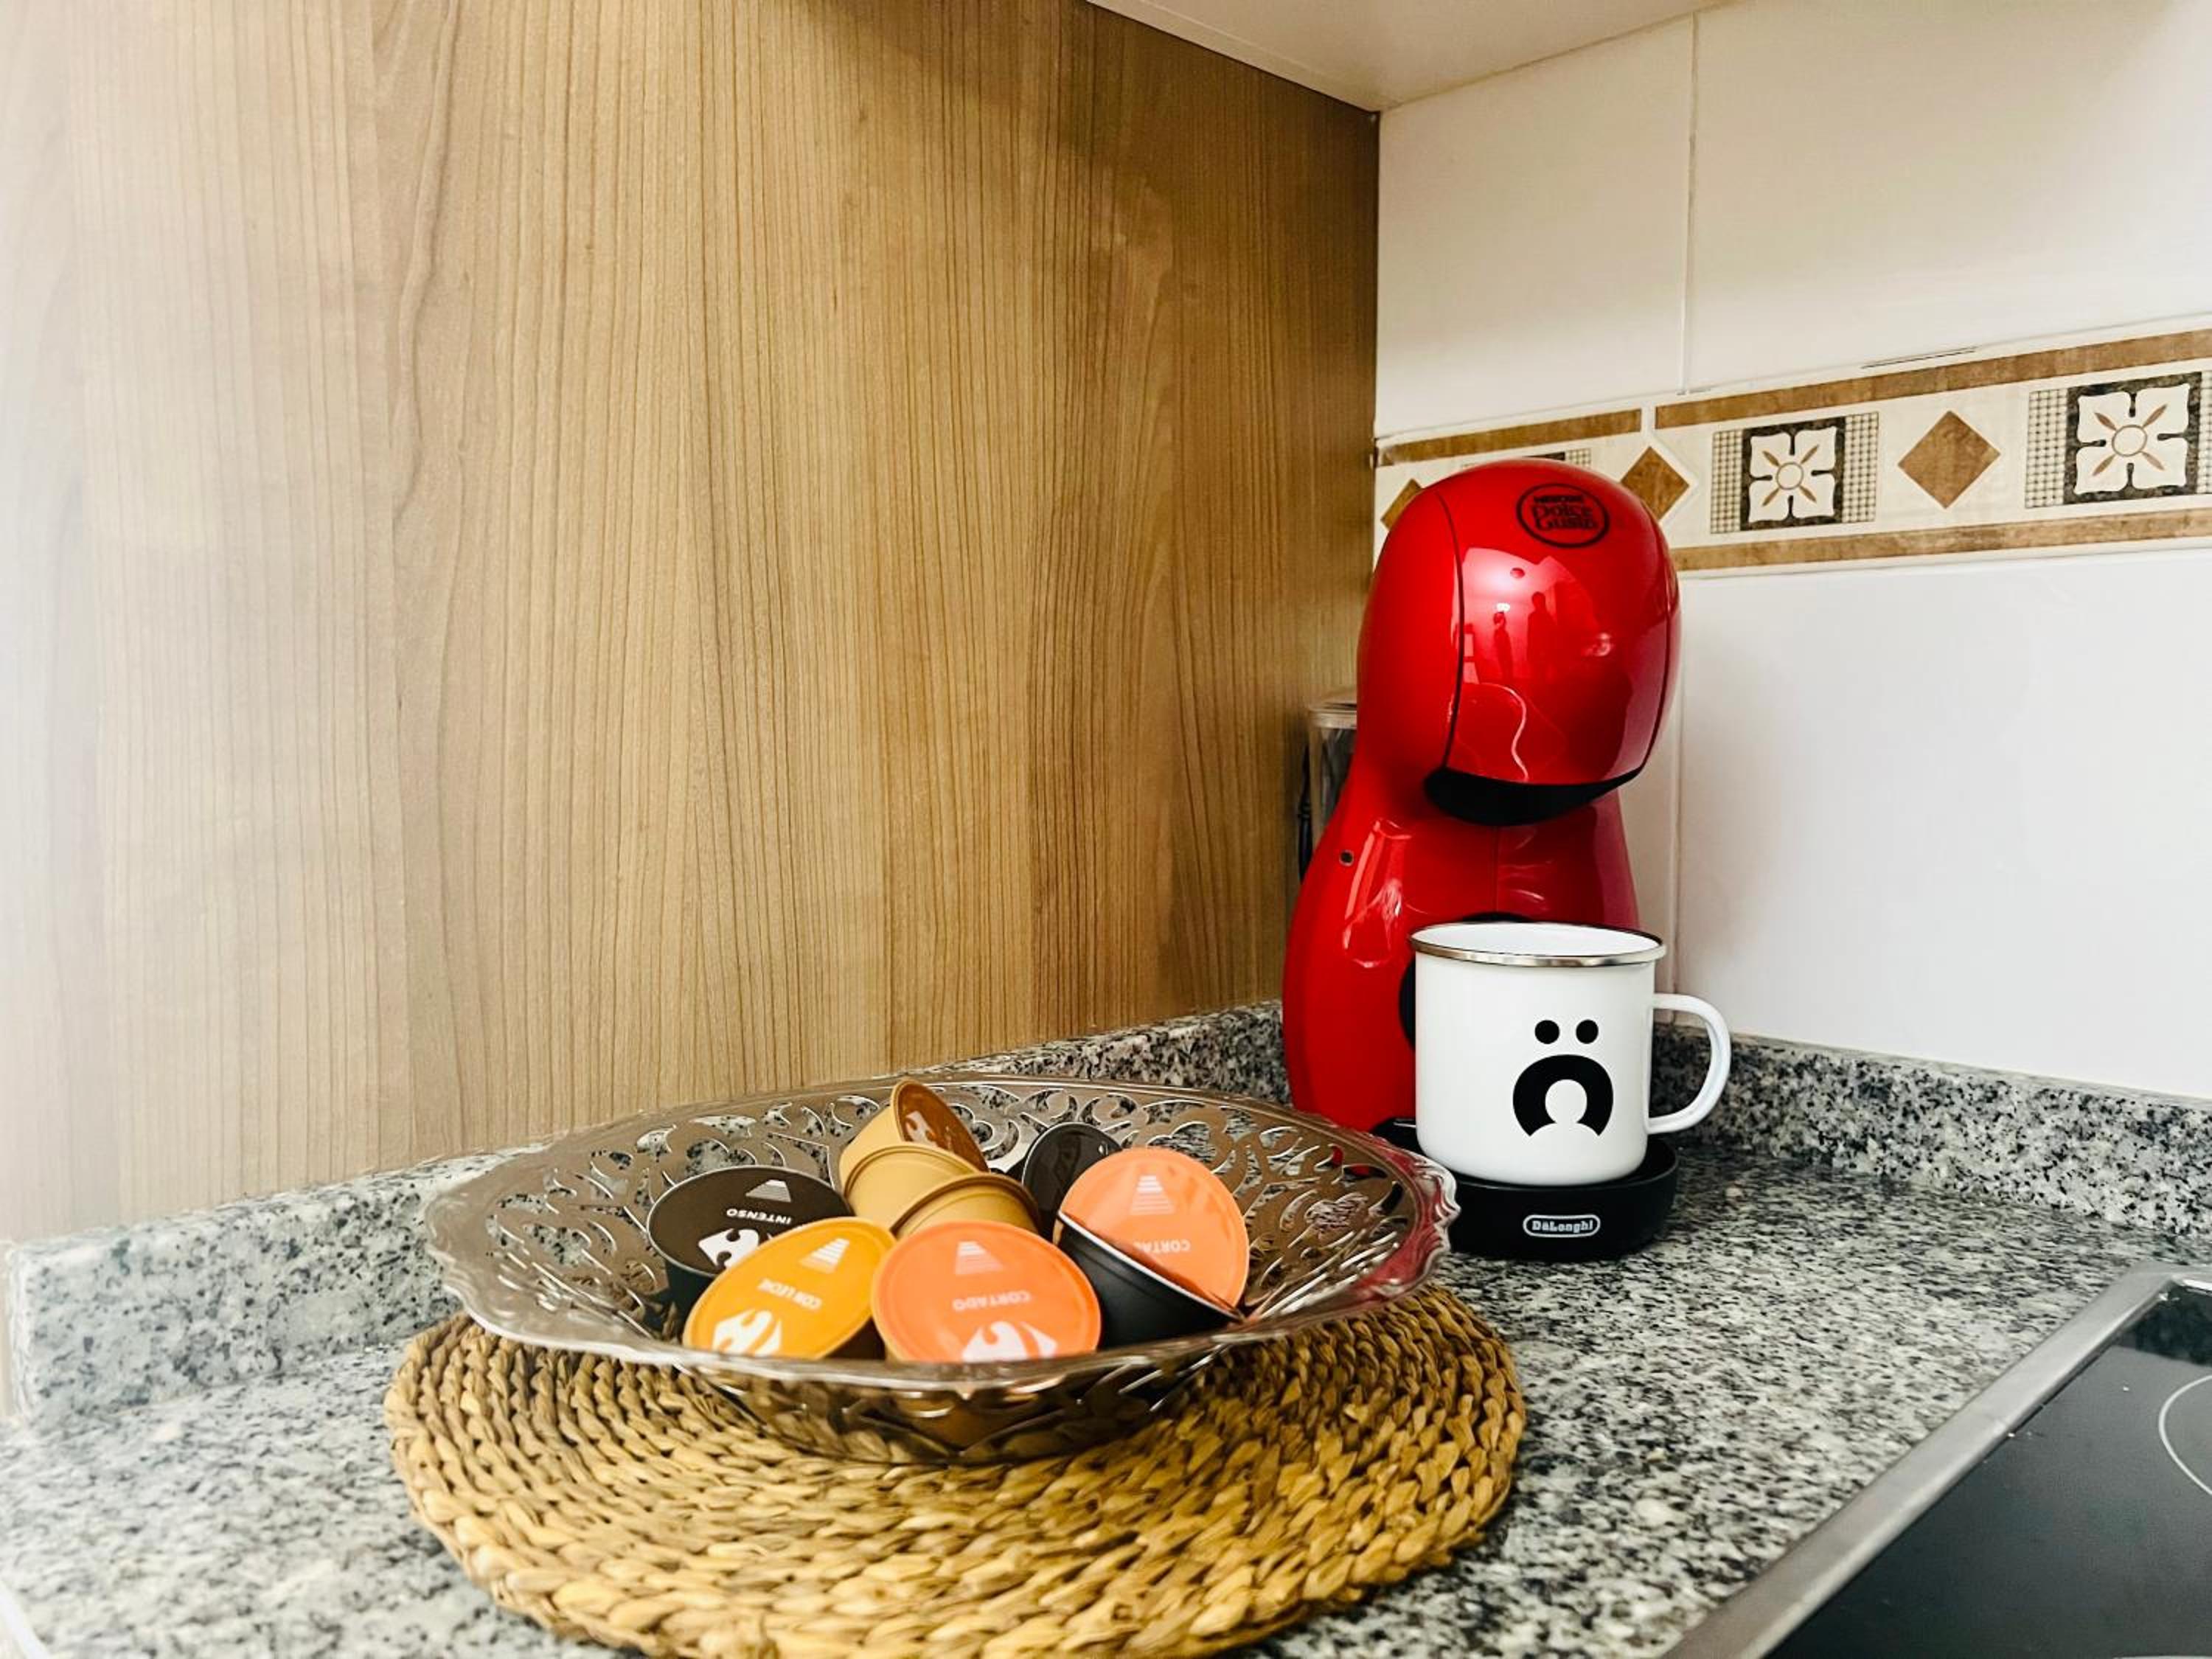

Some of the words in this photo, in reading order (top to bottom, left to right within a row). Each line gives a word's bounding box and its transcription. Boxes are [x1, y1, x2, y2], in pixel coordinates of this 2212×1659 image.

[726, 1208, 792, 1225] INTENSO
[1133, 1239, 1192, 1253] CORTA
[792, 1290, 823, 1310] CON
[952, 1290, 1031, 1311] CORTADO
